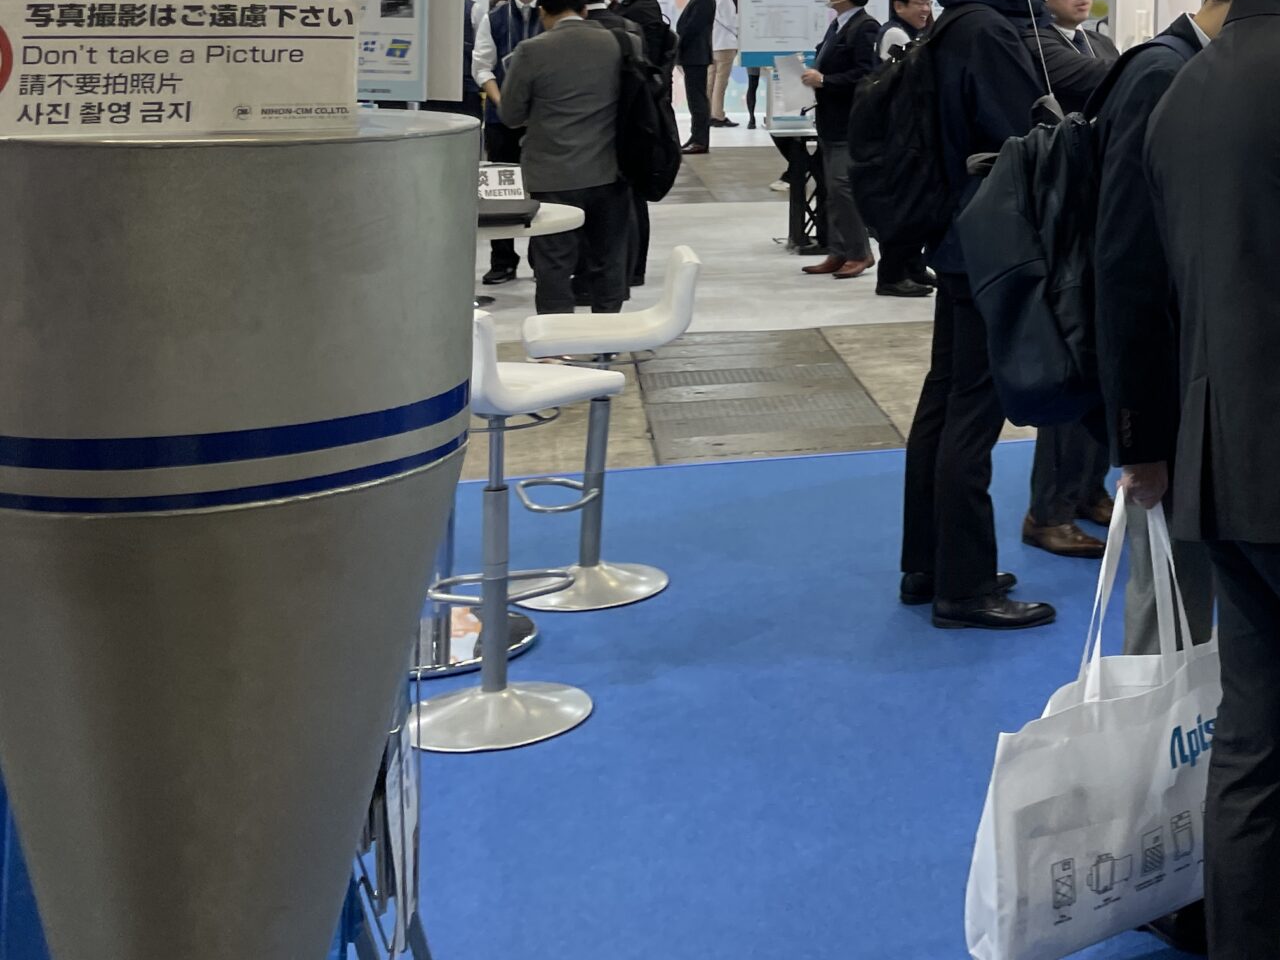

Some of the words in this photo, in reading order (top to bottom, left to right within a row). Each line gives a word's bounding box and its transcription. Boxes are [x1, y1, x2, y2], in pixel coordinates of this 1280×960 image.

[25, 3, 355, 28] 写真撮影はご遠慮下さい
[22, 44, 97, 66] Don't
[109, 44, 169, 64] take
[179, 49, 195, 64] a
[206, 44, 304, 64] Picture
[18, 72, 183, 96] 請不要拍照片
[17, 101, 71, 125] 사진
[79, 100, 132, 125] 촬영
[139, 100, 192, 123] 금지
[485, 188, 522, 197] MEETING
